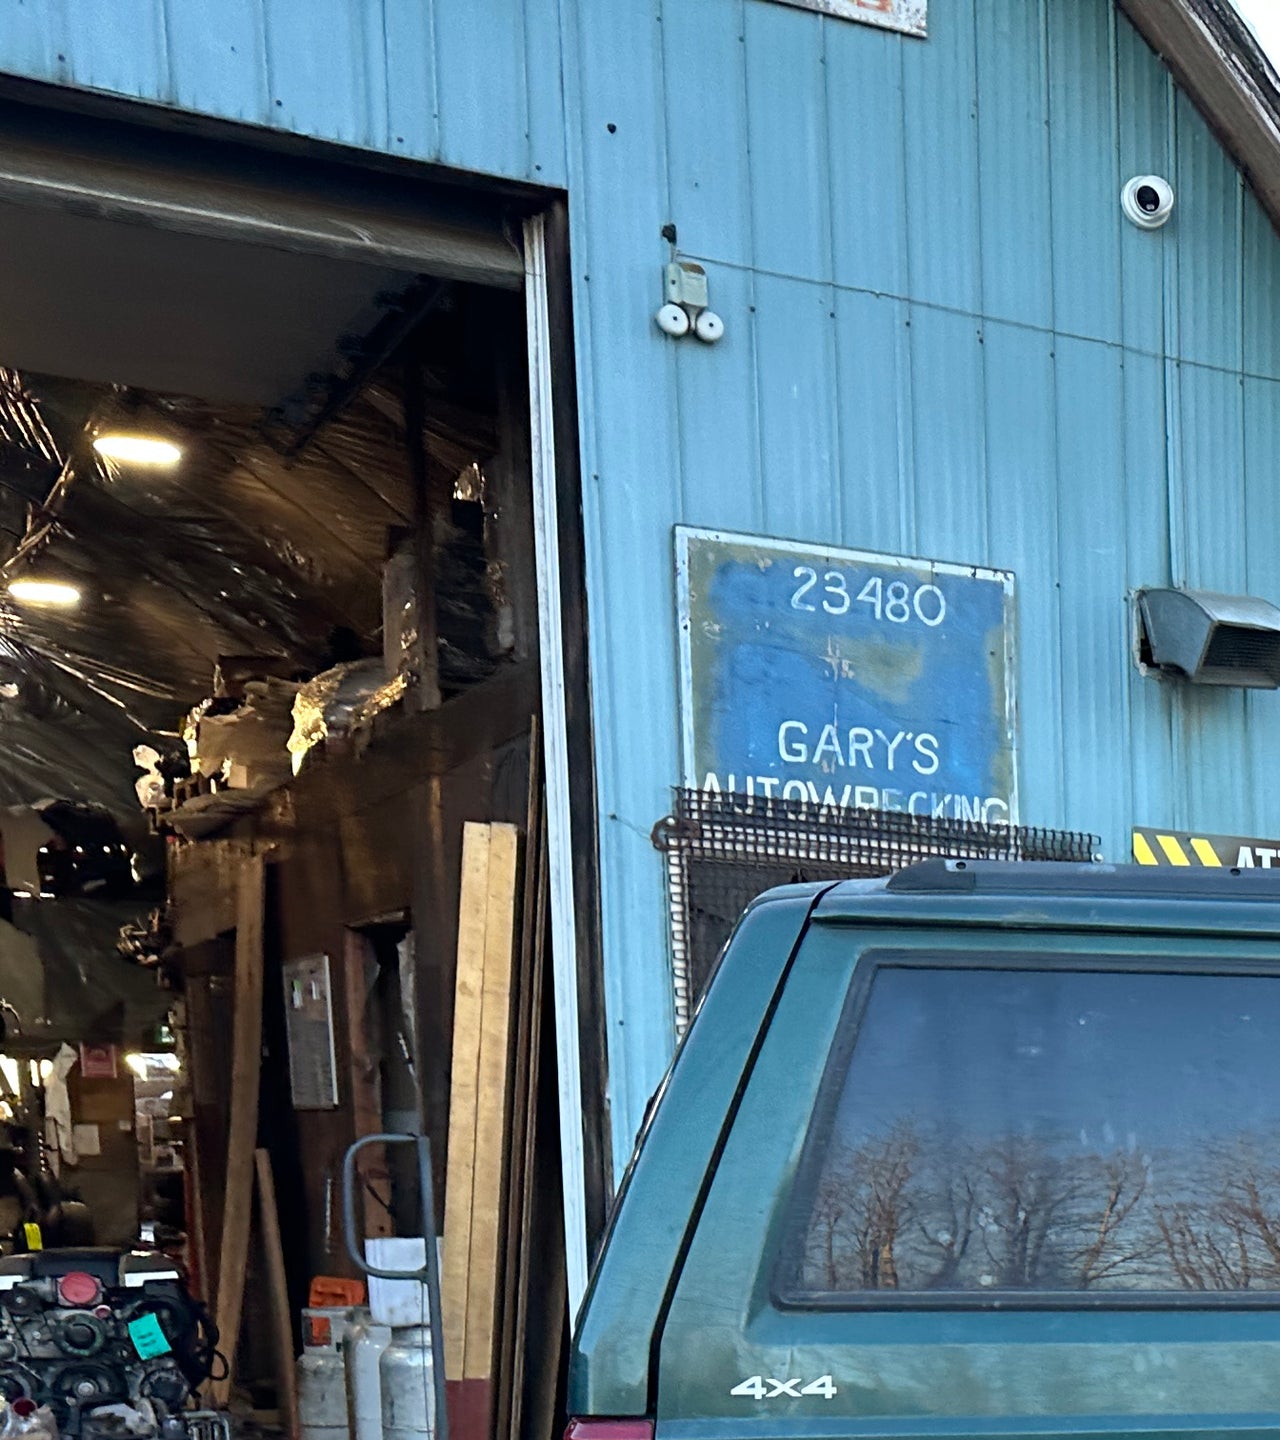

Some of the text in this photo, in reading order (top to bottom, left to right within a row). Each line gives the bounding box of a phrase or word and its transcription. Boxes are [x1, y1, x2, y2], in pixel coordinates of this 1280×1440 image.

[790, 566, 946, 627] 23480
[778, 720, 939, 775] GARY'S
[701, 772, 1010, 836] AUTOWRECKING
